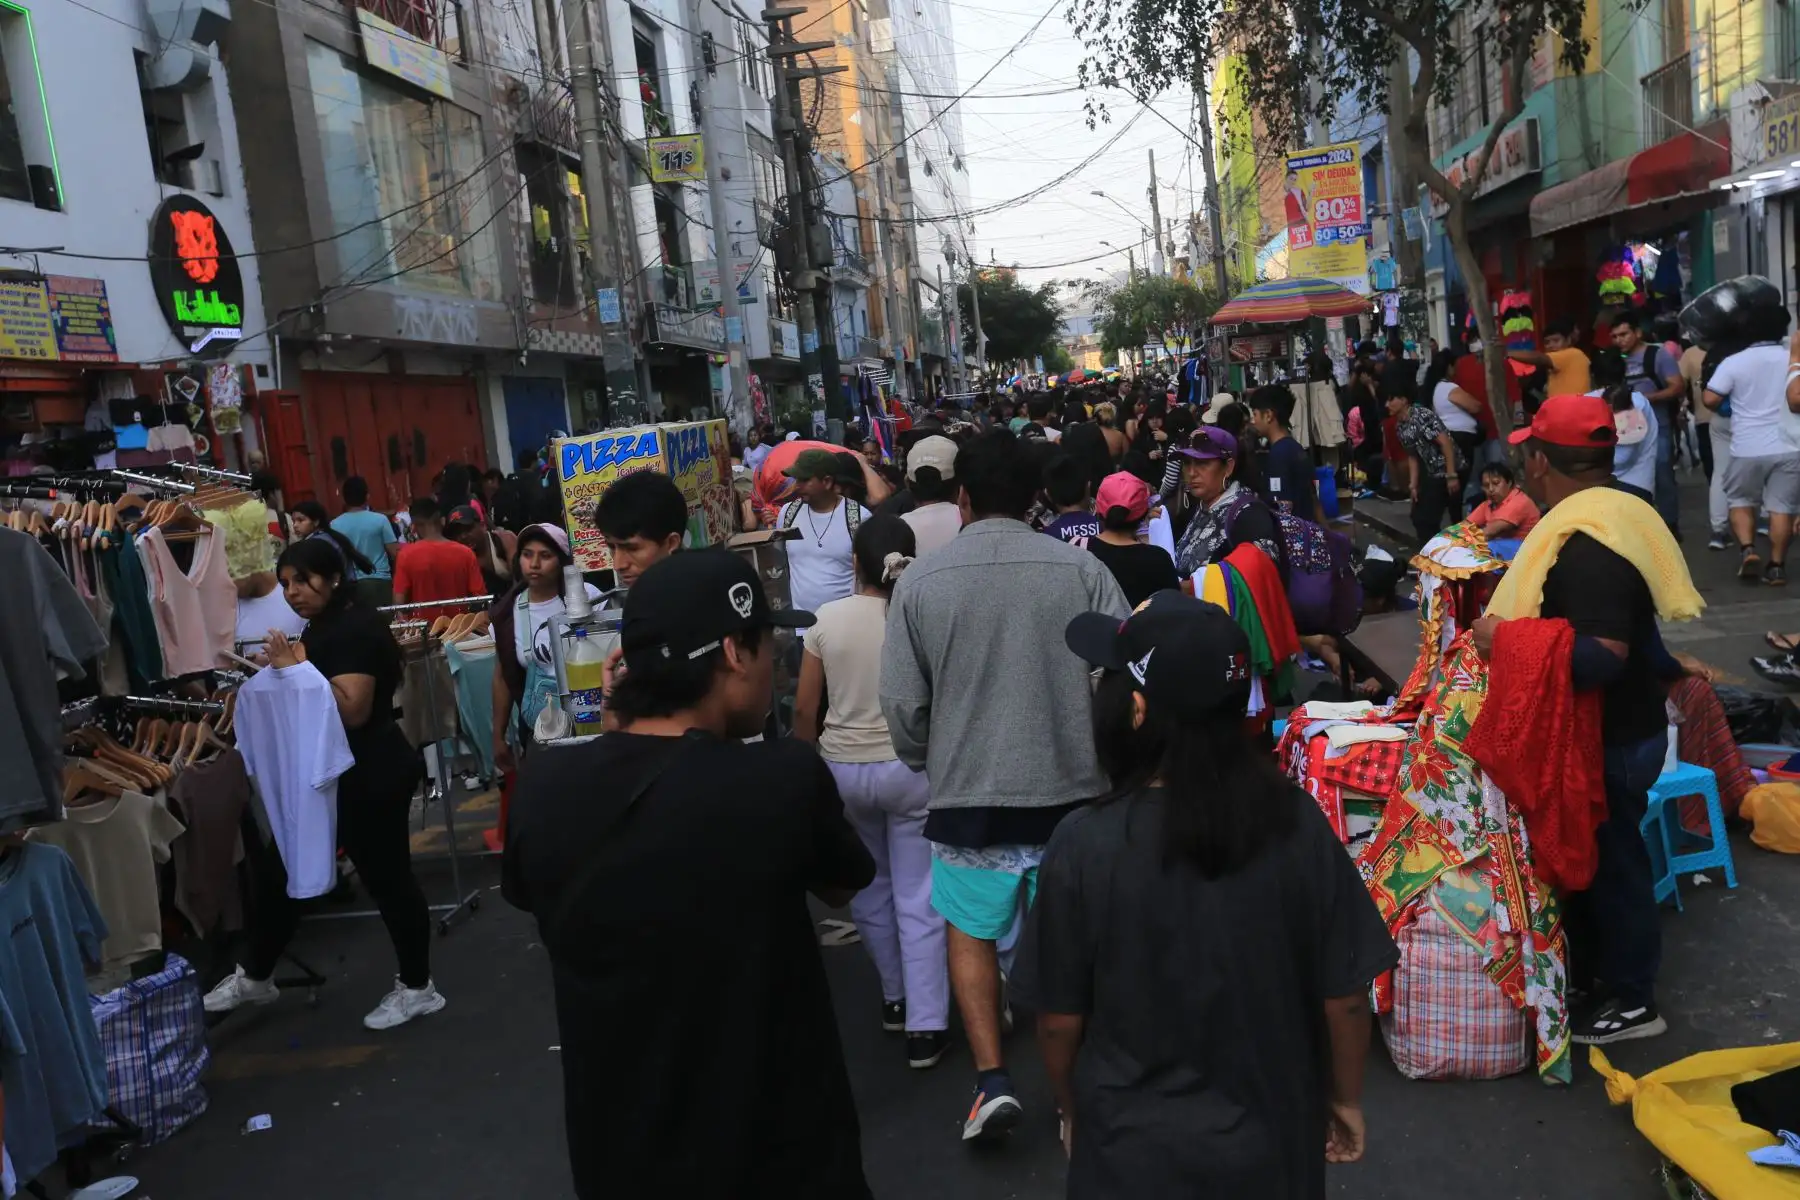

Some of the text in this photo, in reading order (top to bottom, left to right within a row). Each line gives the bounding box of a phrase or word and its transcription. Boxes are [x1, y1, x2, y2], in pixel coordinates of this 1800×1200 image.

[1328, 148, 1352, 164] 2024
[1768, 114, 1798, 157] 581
[1327, 166, 1357, 179] DEUDAS
[561, 431, 660, 481] PIZZA
[665, 426, 711, 481] PIZZA
